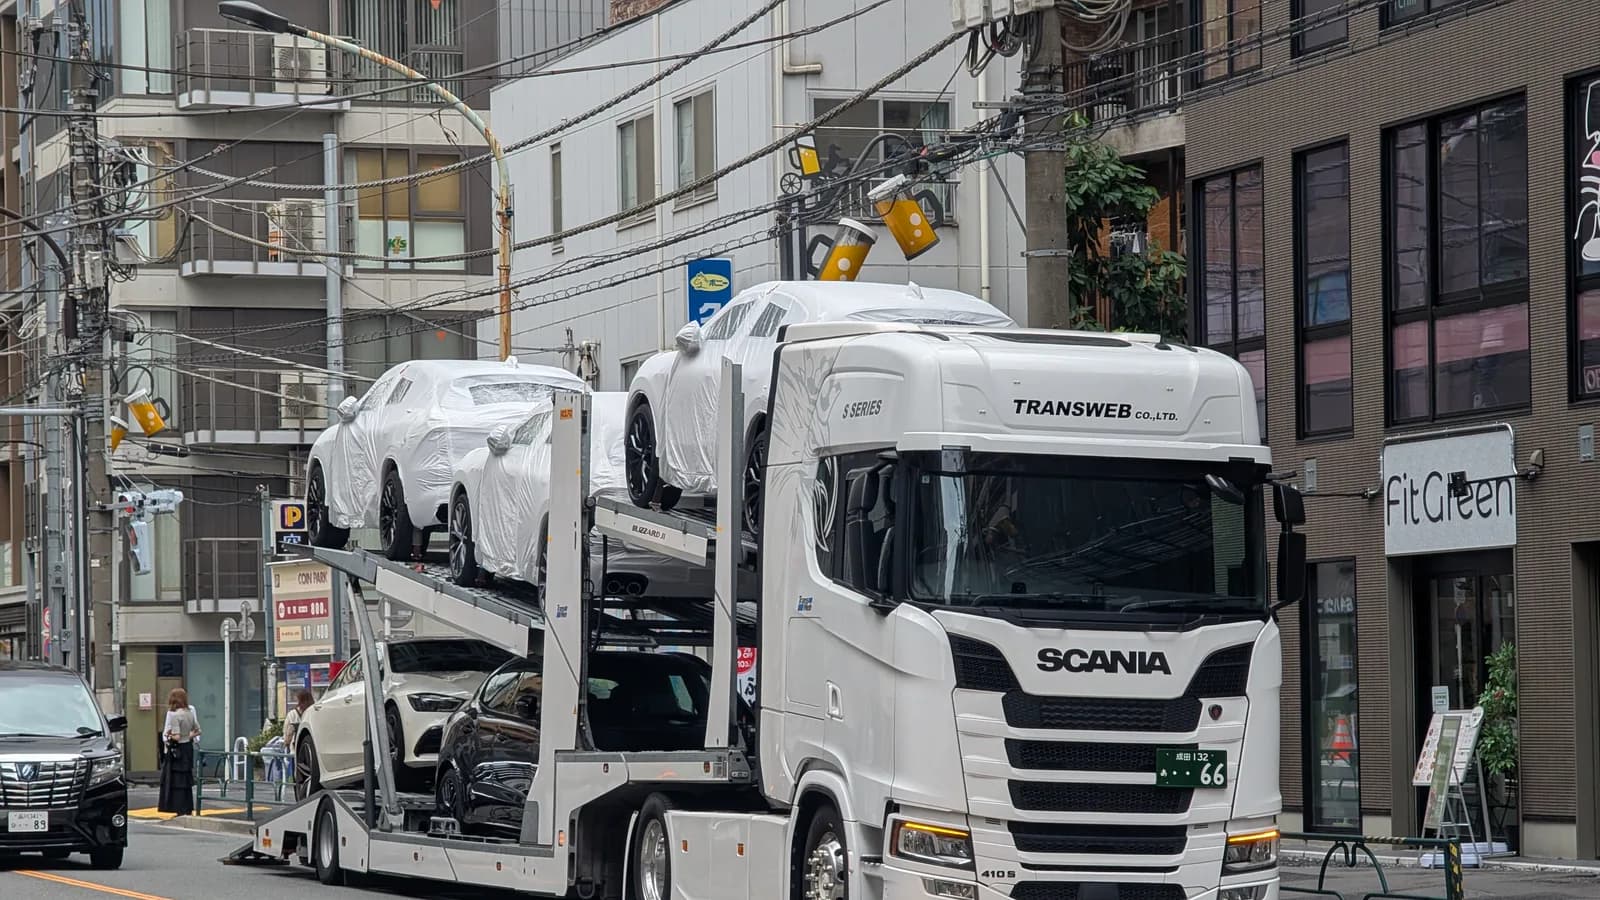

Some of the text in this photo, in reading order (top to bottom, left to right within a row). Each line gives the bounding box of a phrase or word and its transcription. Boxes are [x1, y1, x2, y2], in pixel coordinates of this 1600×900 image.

[842, 400, 882, 419] S SERIES
[1013, 399, 1178, 421] TRANSWEB CO.,LTD.
[285, 506, 301, 527] P
[631, 525, 660, 538] BLIZZARD
[298, 571, 328, 585] COIN PARK
[1036, 648, 1172, 675] SCANIA
[1193, 753, 1209, 761] 132
[1200, 763, 1224, 785] 66
[34, 820, 46, 830] 89
[981, 870, 1016, 878] 410 S
